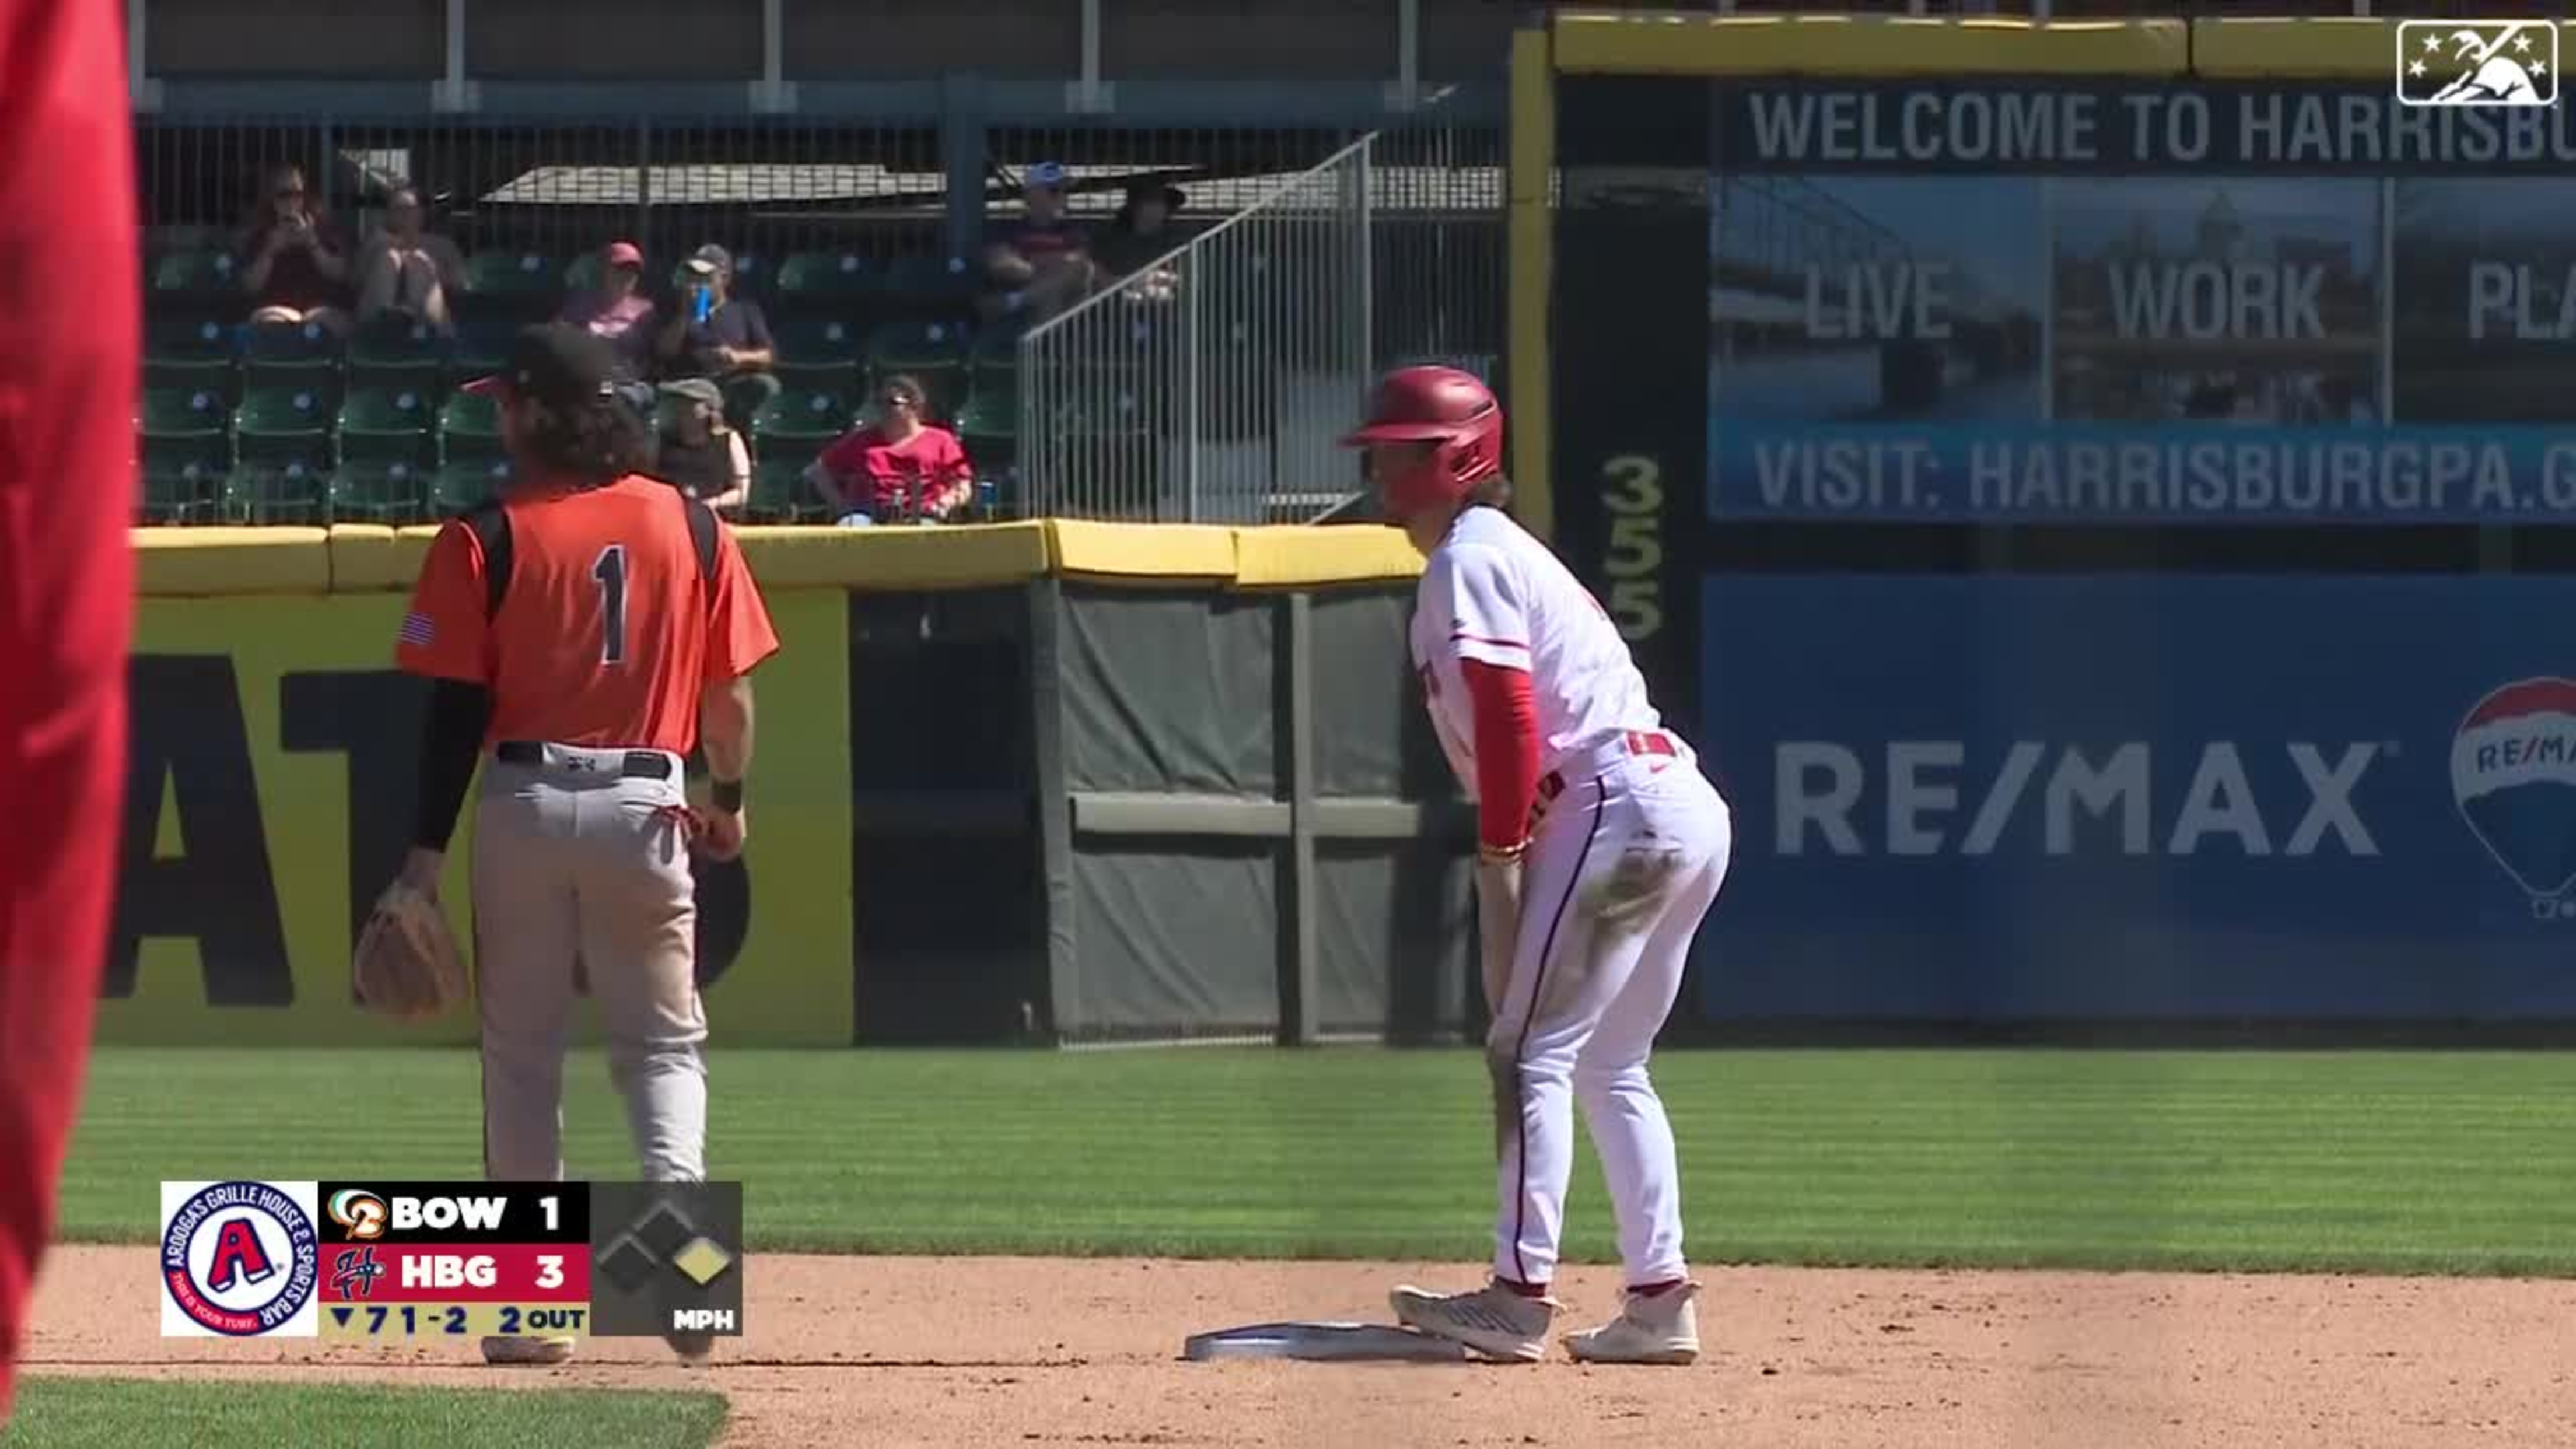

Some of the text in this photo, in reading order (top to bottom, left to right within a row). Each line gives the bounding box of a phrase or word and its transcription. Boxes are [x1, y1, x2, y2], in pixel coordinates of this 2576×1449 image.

[1754, 93, 2097, 160] WELCOME
[2124, 93, 2210, 160] TO
[1805, 262, 1952, 339] LIVE
[2110, 263, 2326, 340] WORK
[1756, 442, 1940, 507] VISIT:
[1604, 455, 1662, 640] 355
[593, 544, 628, 665] 1
[2477, 735, 2576, 773] RE/M
[1774, 741, 2383, 855] RE/MAX
